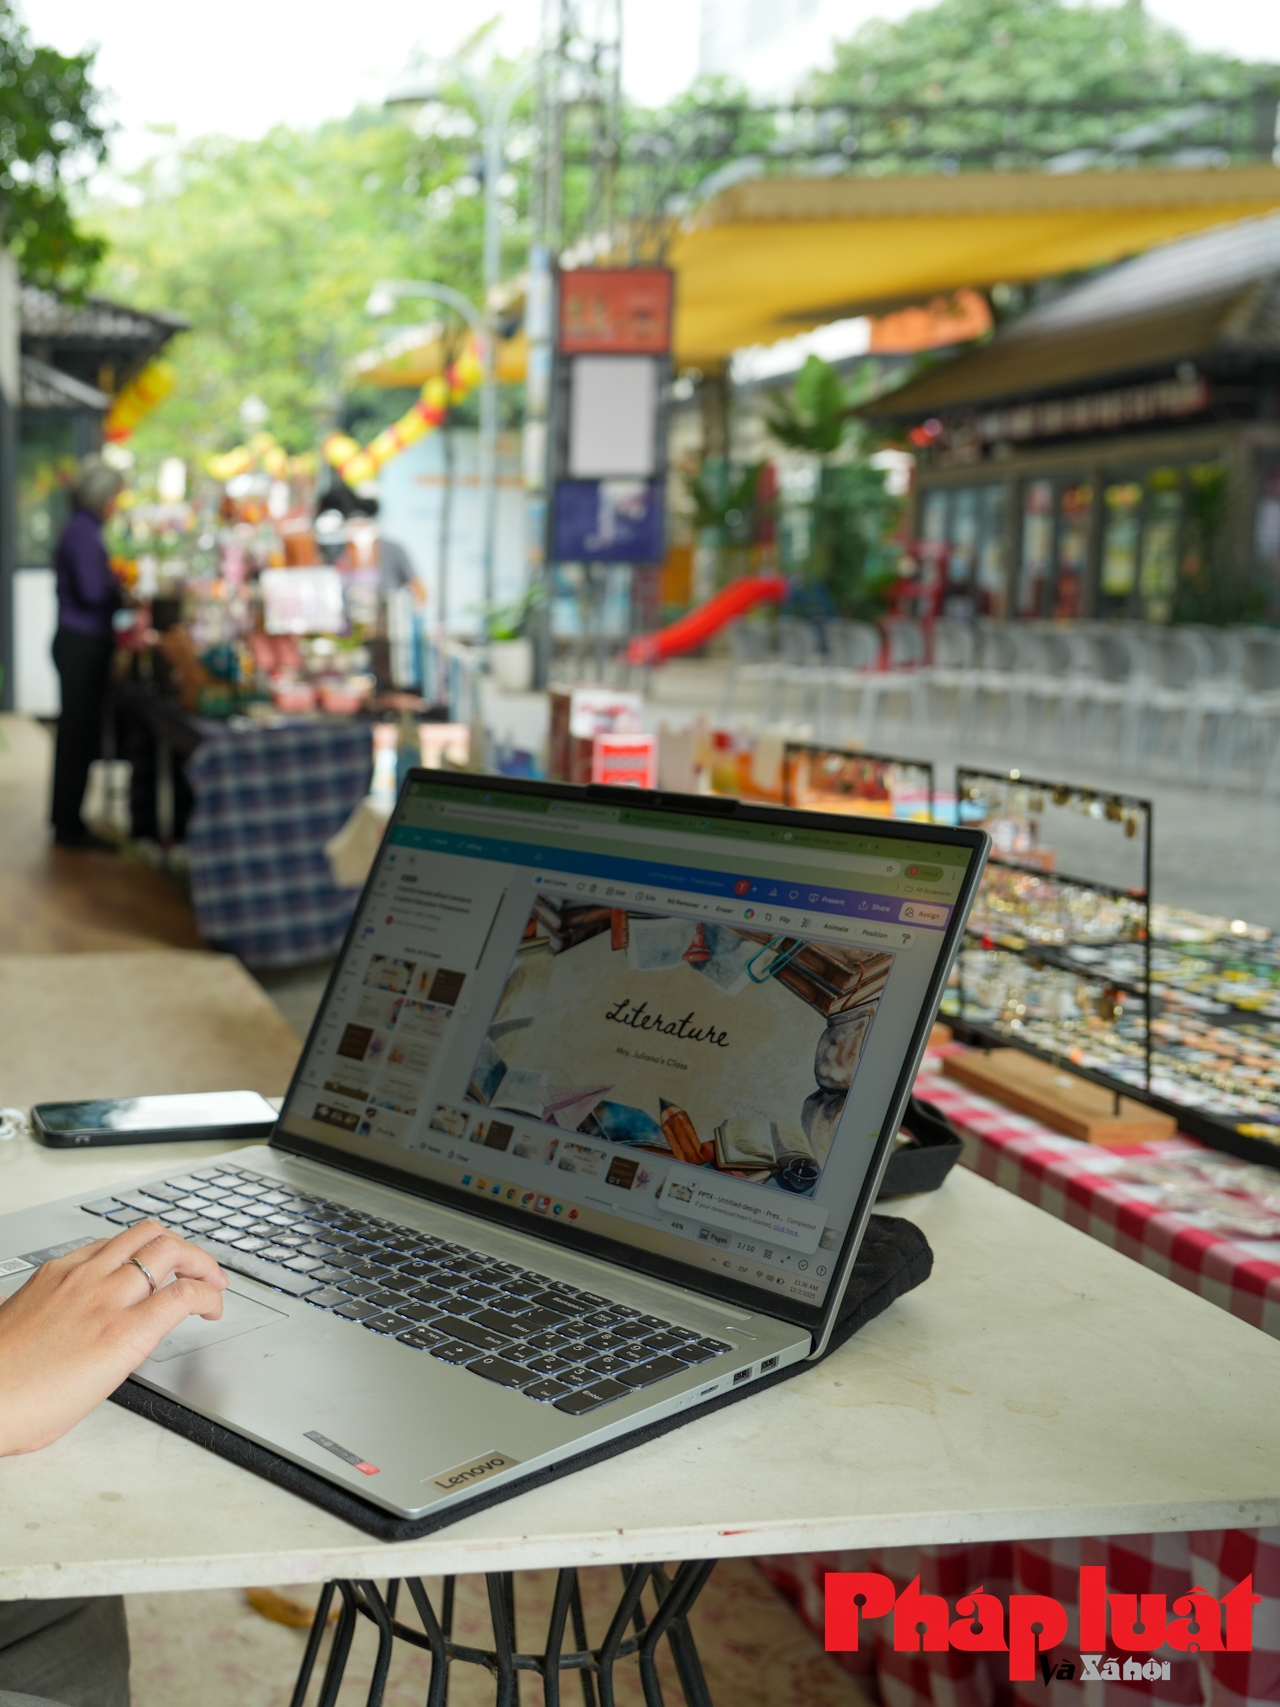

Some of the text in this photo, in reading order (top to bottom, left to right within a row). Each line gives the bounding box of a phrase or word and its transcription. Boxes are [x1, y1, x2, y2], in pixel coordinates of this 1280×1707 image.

[821, 895, 845, 906] Present
[715, 905, 734, 914] Eraser
[871, 903, 891, 913] Share
[779, 915, 791, 924] Flip
[918, 910, 940, 920] Assign
[823, 922, 849, 933] Animate
[862, 929, 888, 940] Position
[605, 998, 729, 1047] Literature
[615, 1046, 688, 1071] Mrs. Juliana's Class
[697, 1190, 714, 1200] PPTX
[717, 1195, 742, 1209] Untitled
[741, 1202, 762, 1215] design
[699, 1202, 710, 1211] your
[710, 1204, 736, 1218] download
[736, 1212, 752, 1222] hasn't
[773, 1224, 785, 1233] click
[671, 1221, 684, 1231] 48%
[786, 1217, 816, 1231] Completed
[710, 1233, 728, 1245] Pages
[738, 1265, 749, 1273] ESP
[794, 1279, 819, 1292] 11:36 AM
[585, 1293, 603, 1303] Delete
[789, 1286, 816, 1299] 12/2/2025
[346, 1303, 359, 1311] Ctrl
[552, 1296, 585, 1312] Backspace
[594, 1315, 607, 1323] Lock
[599, 1313, 613, 1322] Num
[510, 1323, 531, 1333] Enter
[484, 1336, 502, 1345] Shift
[581, 1389, 604, 1401] Enter
[434, 1456, 505, 1490] Lenovo
